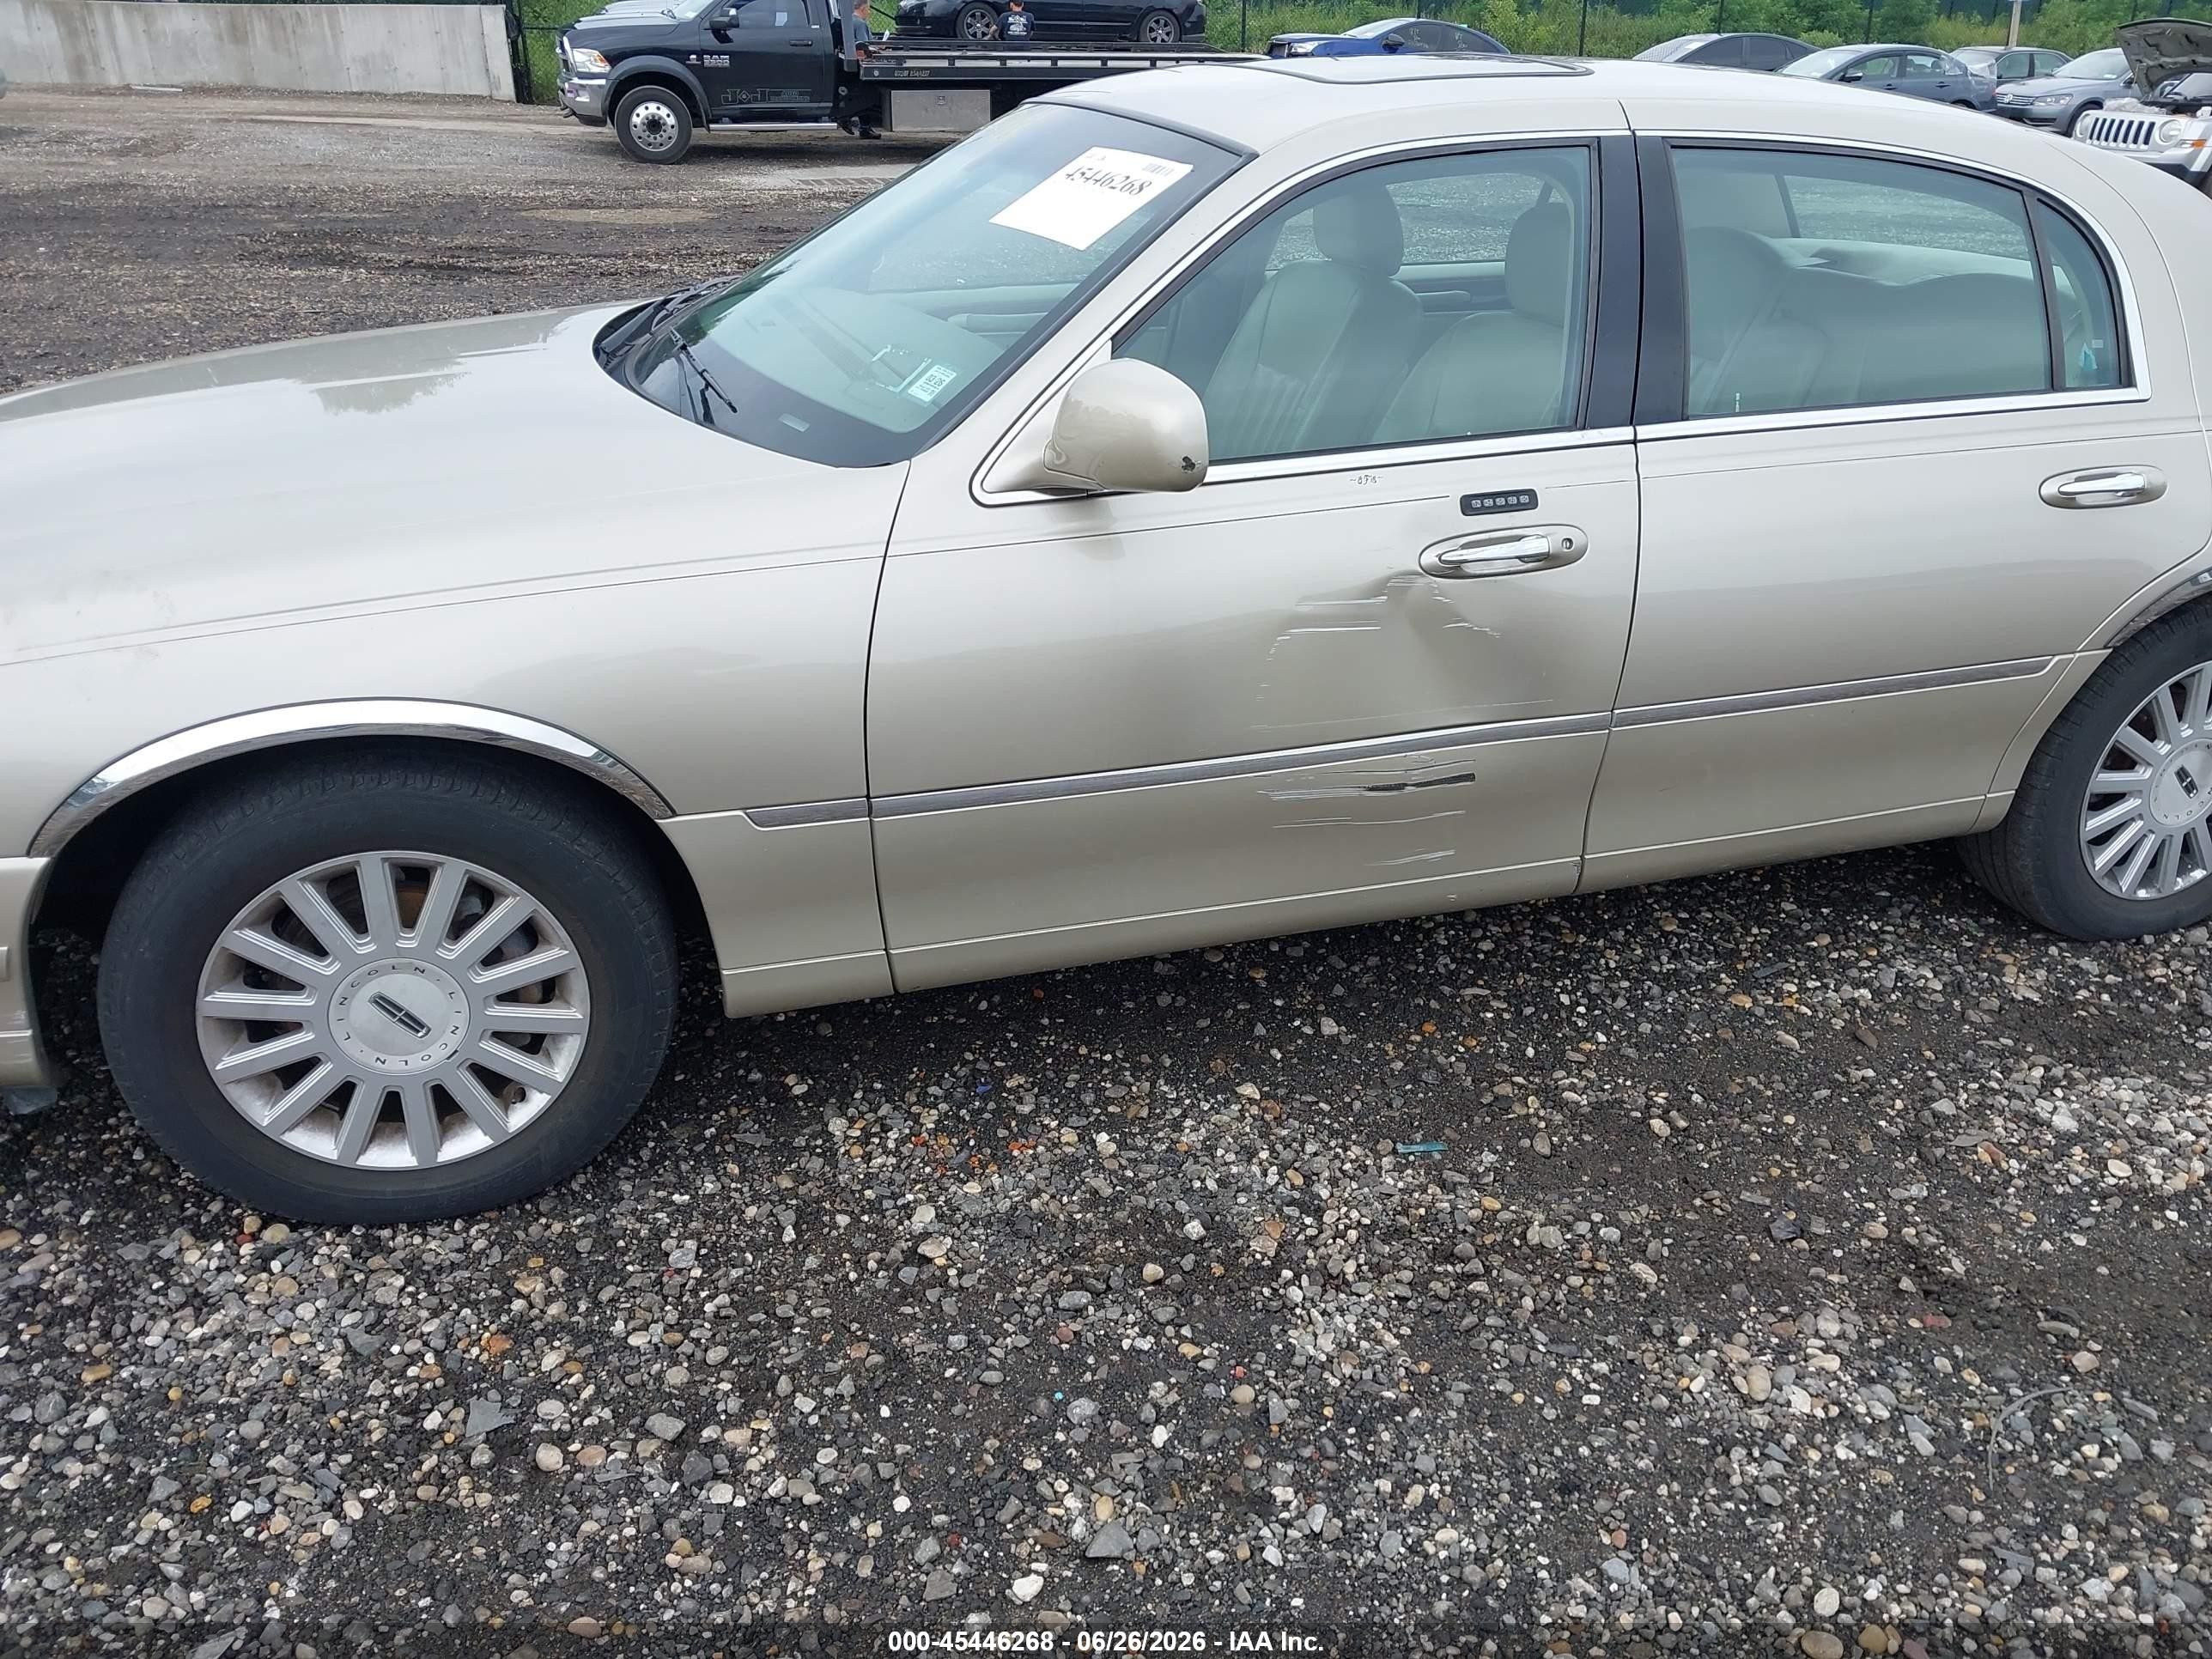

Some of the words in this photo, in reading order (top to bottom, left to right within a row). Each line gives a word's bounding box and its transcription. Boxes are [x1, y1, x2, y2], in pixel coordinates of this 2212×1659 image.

[1065, 167, 1152, 197] 45446268
[337, 965, 426, 1042] LINCOLN
[374, 990, 462, 1066] LINCOLN
